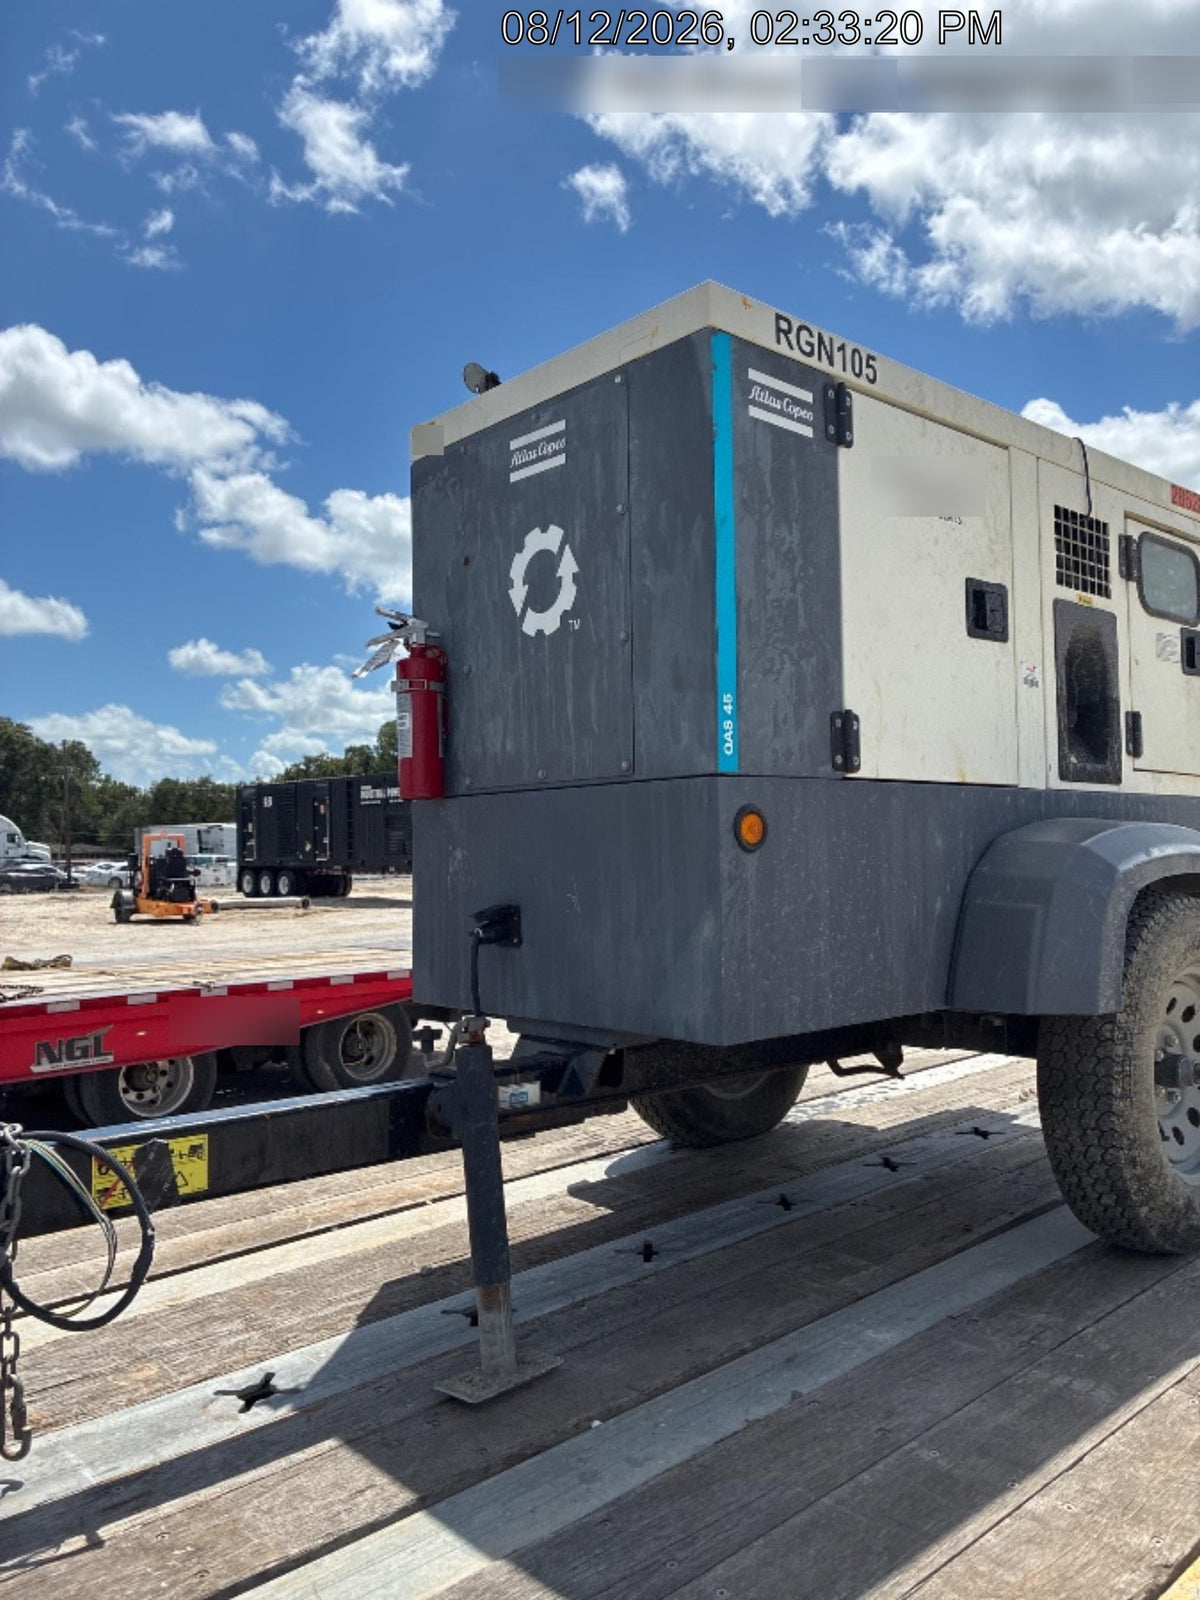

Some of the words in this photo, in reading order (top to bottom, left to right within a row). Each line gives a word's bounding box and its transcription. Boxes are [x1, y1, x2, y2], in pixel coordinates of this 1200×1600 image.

[775, 312, 878, 385] RGN105
[748, 385, 782, 410] Atlas
[782, 397, 813, 422] Copco
[510, 447, 539, 469] Atlas
[722, 692, 734, 716] 45
[722, 719, 734, 756] QAS
[36, 1032, 114, 1066] NGL
